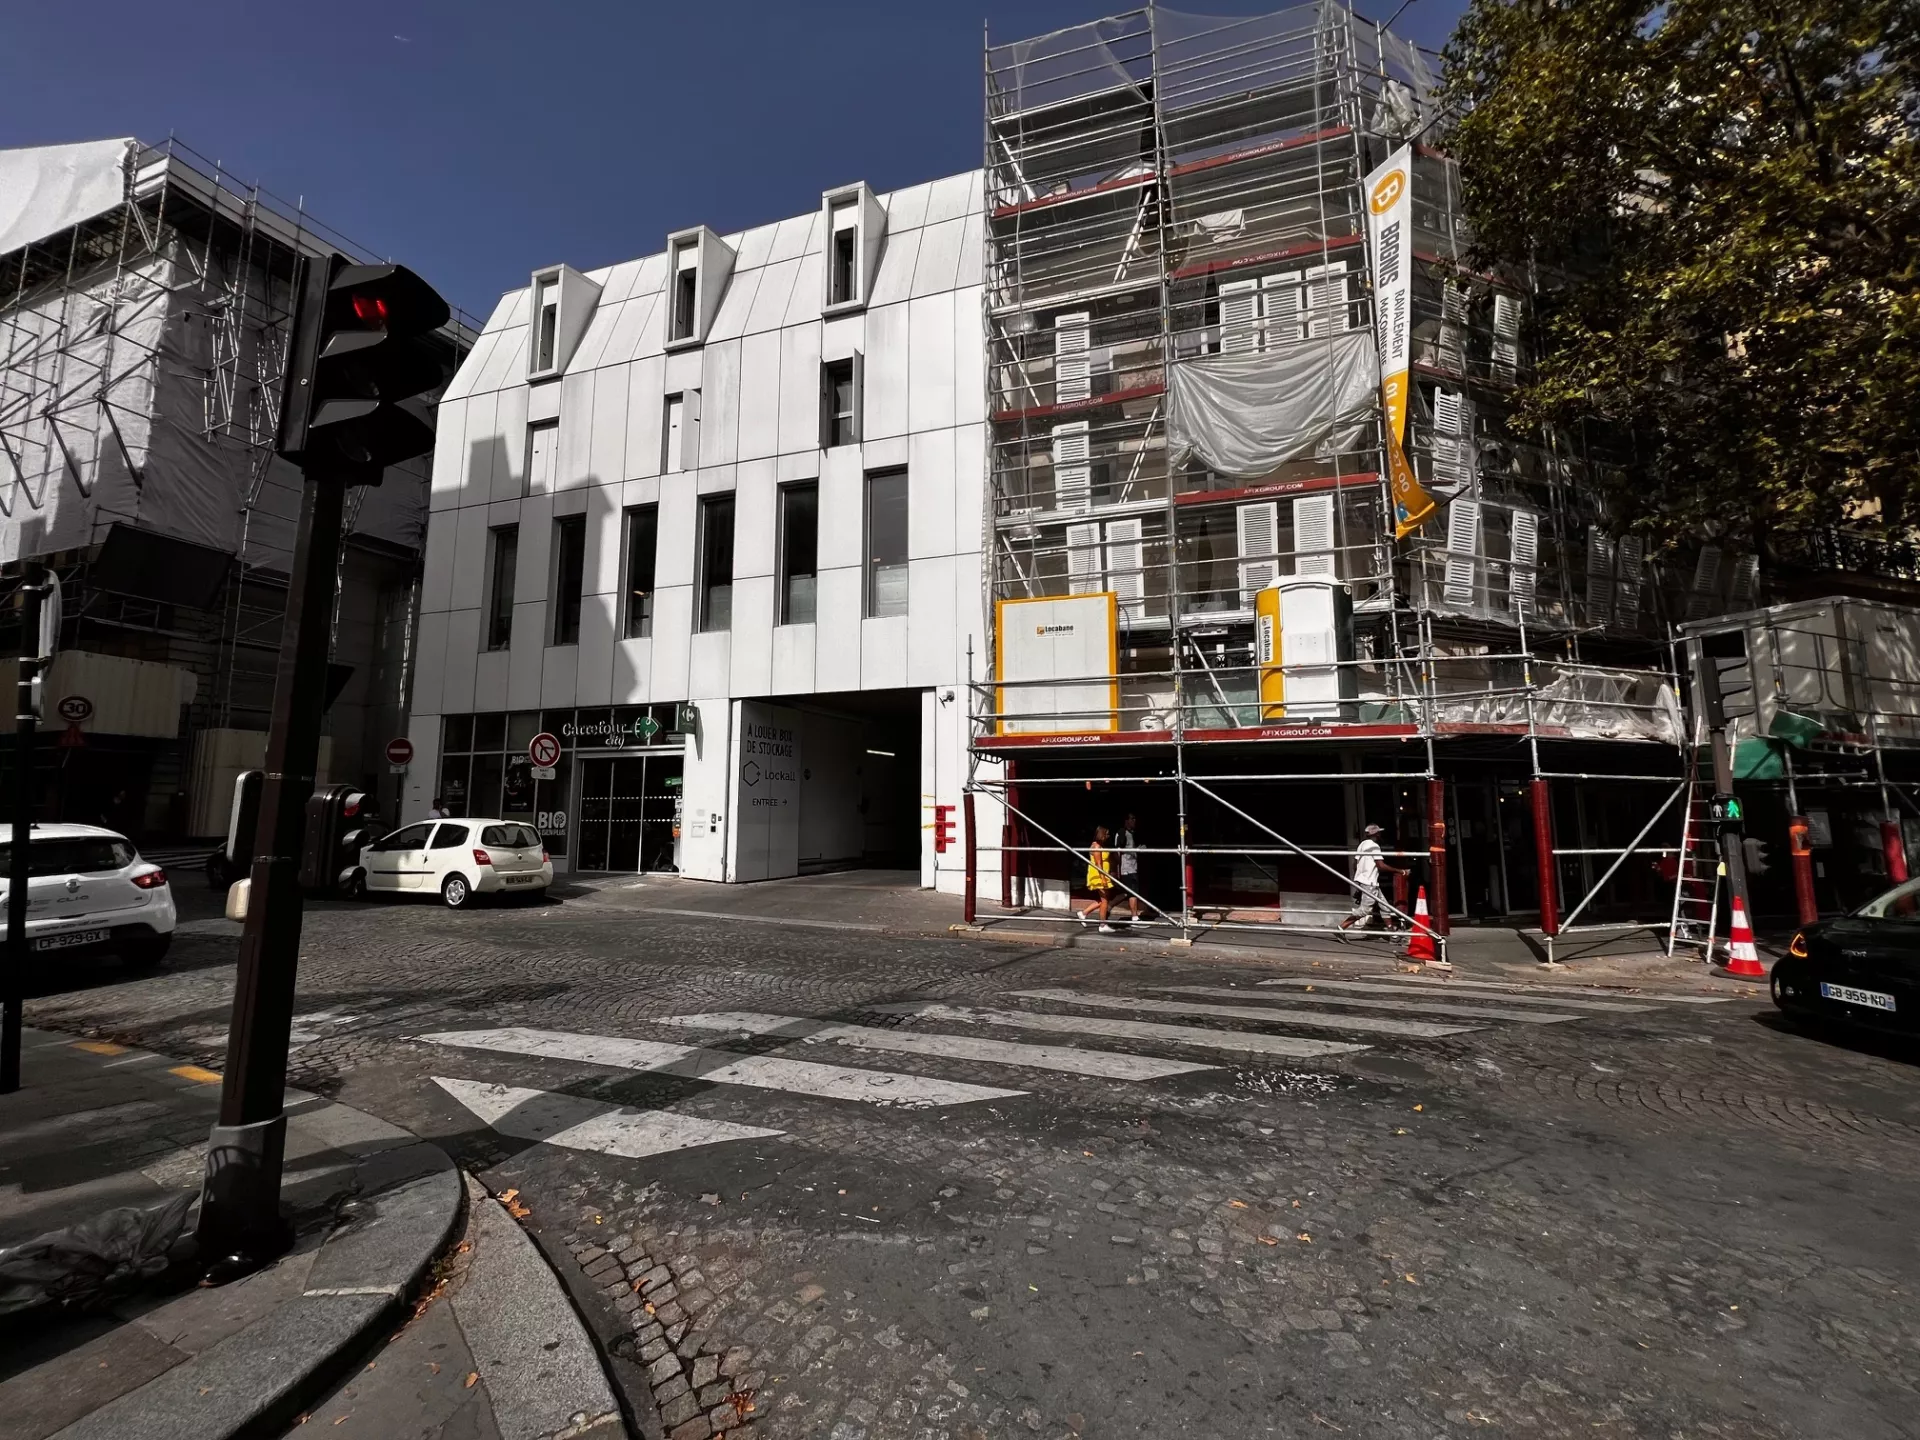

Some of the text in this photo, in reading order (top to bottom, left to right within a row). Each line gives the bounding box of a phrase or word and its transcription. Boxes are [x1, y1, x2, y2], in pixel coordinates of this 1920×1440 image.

[1379, 220, 1400, 289] BAGNIS
[1392, 288, 1405, 359] RAVALEMENT
[64, 702, 87, 714] 30
[562, 720, 627, 736] Carrefour
[754, 724, 777, 741] LOUER
[1261, 728, 1332, 737] AFIXGROUP.COM
[1041, 735, 1100, 743] AFIXGROUP.COM
[747, 740, 793, 758] DE STOCKAGE
[538, 810, 567, 829] BIO
[57, 895, 89, 904] CLIO
